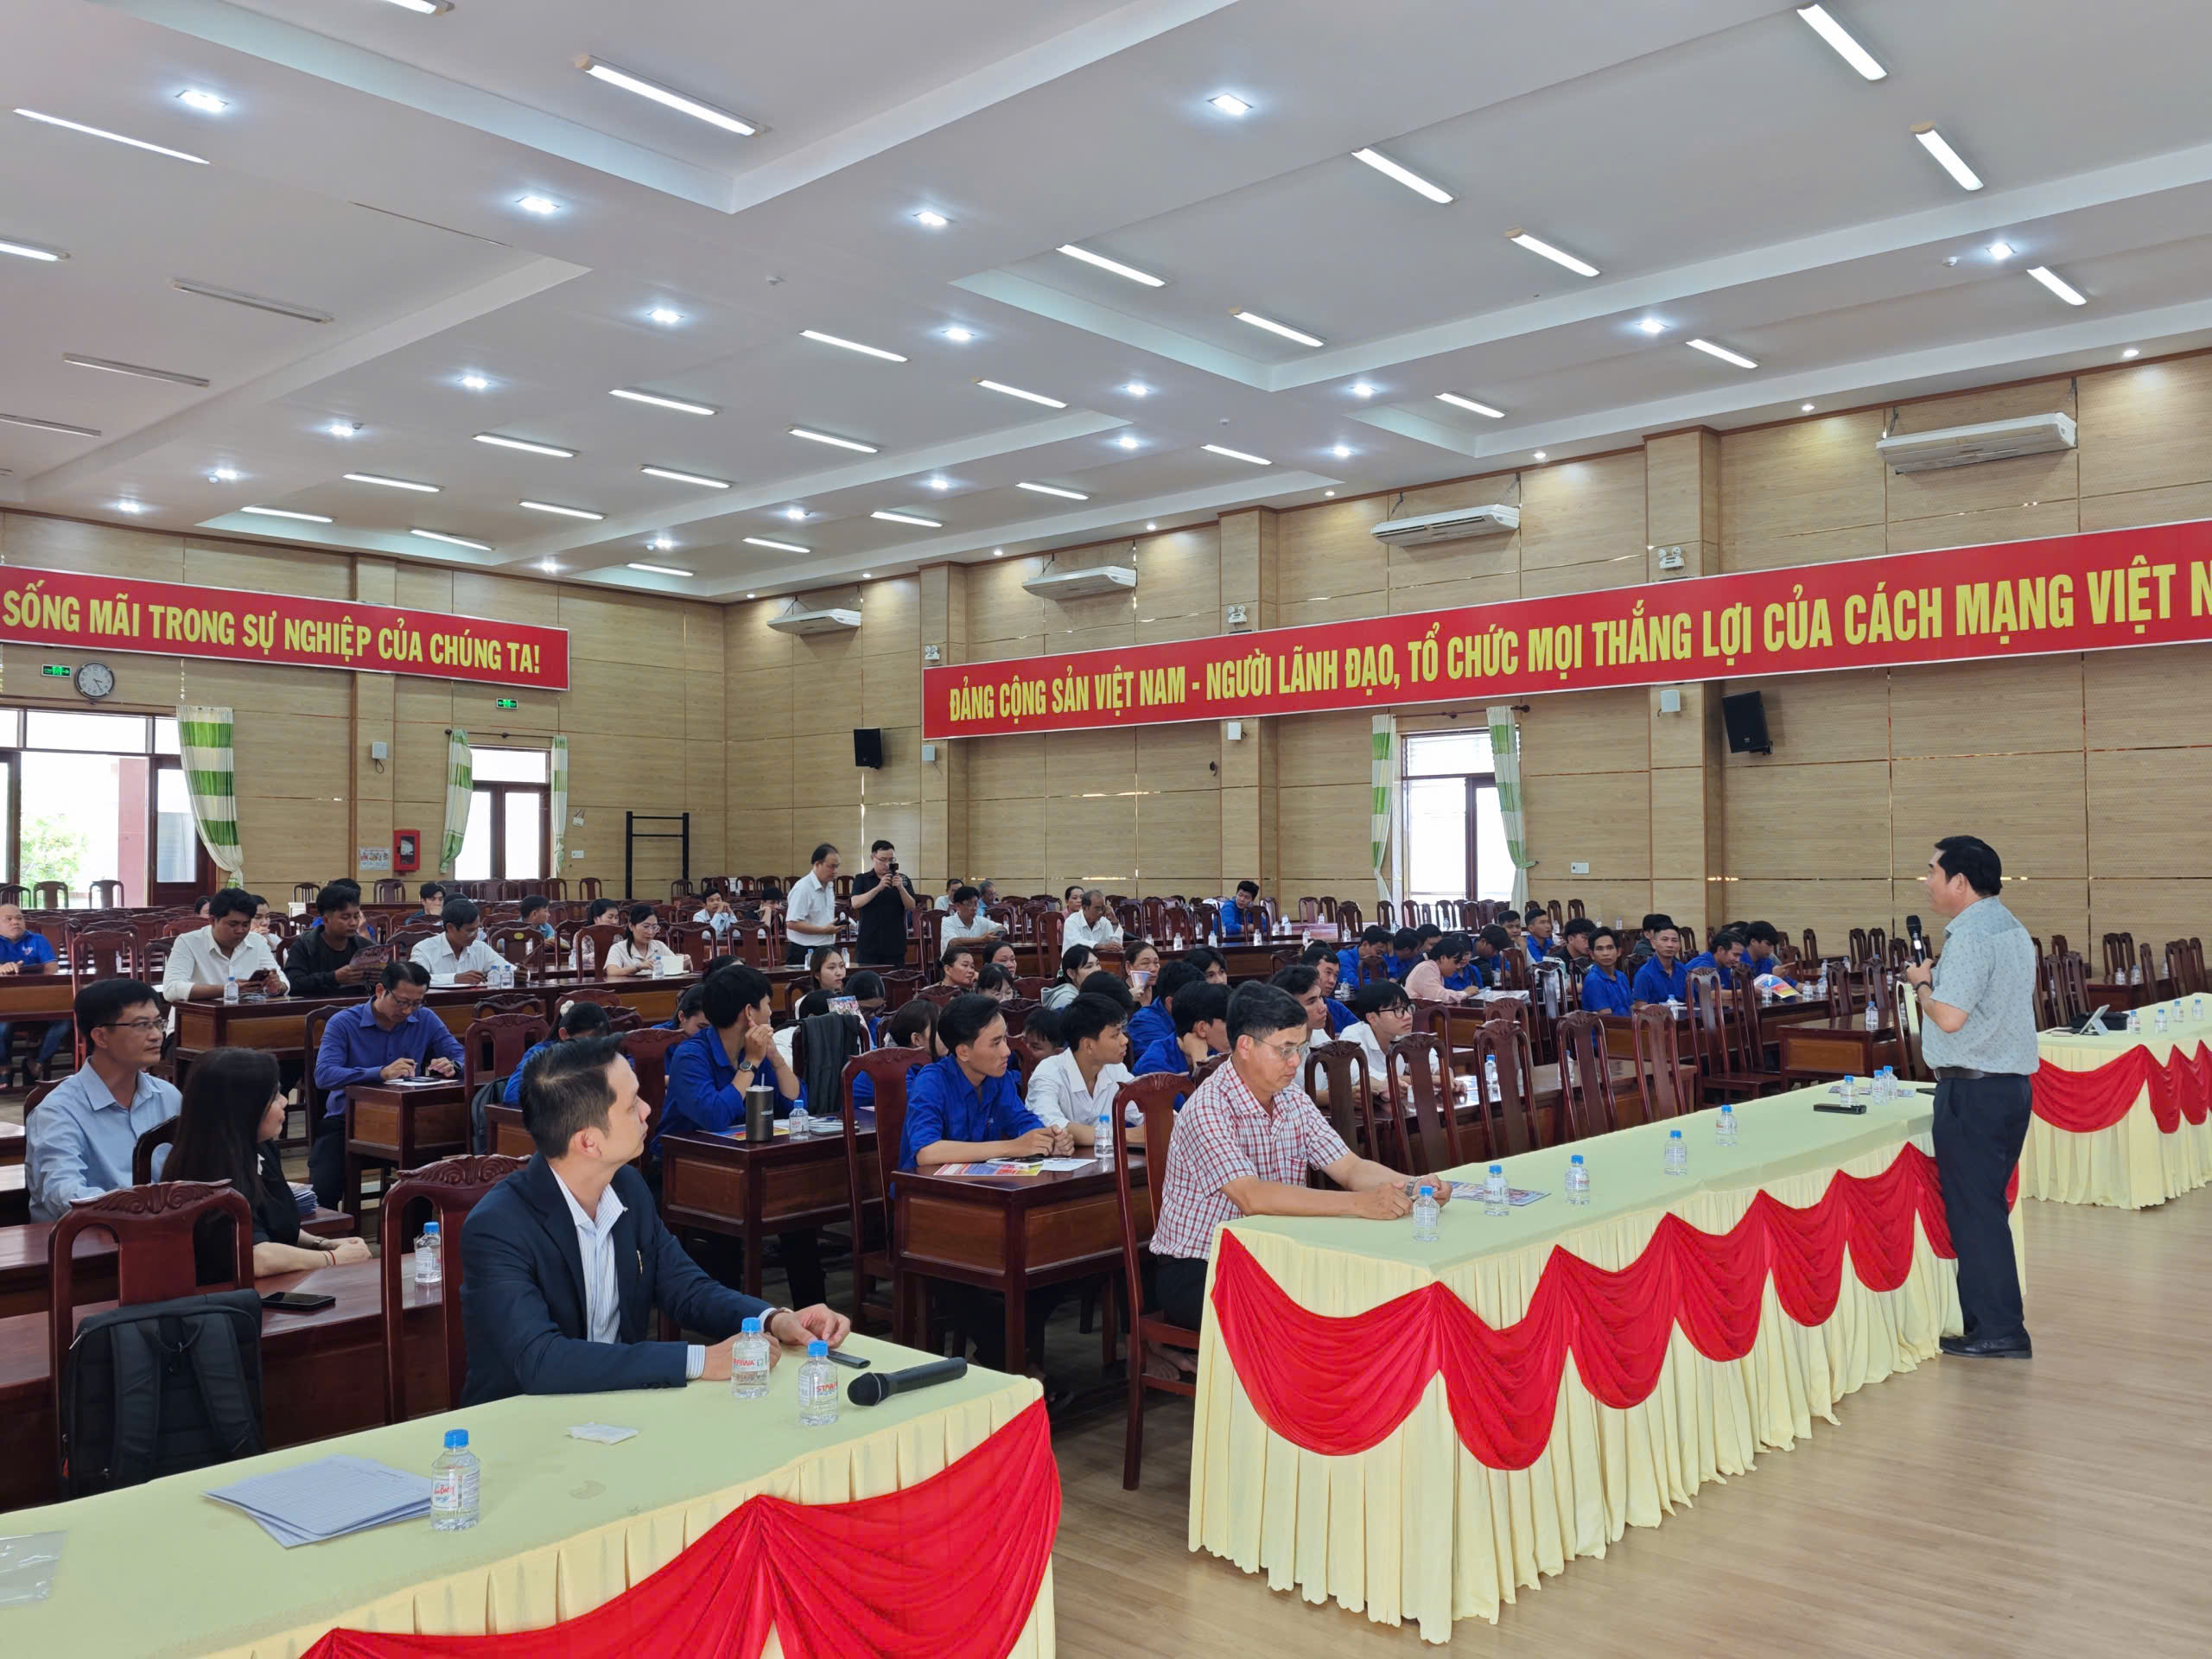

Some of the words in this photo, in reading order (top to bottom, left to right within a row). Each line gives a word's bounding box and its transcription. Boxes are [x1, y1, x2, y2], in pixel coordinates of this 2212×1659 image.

[3, 580, 79, 632] SỐNG
[89, 594, 139, 637] MÃI
[149, 605, 235, 645] TRONG
[242, 611, 276, 654] SỰ
[284, 615, 372, 662] NGHIỆP
[378, 618, 422, 662] CỦA
[430, 629, 501, 671] CHÚNG
[507, 642, 540, 673] TA!
[950, 676, 995, 721] ĐẢNG
[1000, 675, 1046, 724] CỘNG
[1052, 665, 1089, 713] SẢN
[1094, 664, 1134, 716] VIỆT
[1140, 666, 1185, 706] NAM
[1206, 648, 1271, 701] NGƯỜI
[1278, 645, 1338, 694] LÃNH
[1344, 644, 1400, 696] ĐẠO,
[1408, 621, 1440, 683] TỔ
[1447, 624, 1518, 680] CHỨC
[1528, 624, 1582, 680] MỌI
[1591, 600, 1692, 666] THẮNG
[1702, 603, 1751, 666] LỢI
[1764, 584, 1833, 652] CỦA
[1845, 582, 1942, 645] CÁCH
[1955, 574, 2074, 645] MẠNG
[2087, 555, 2176, 634] VIỆT
